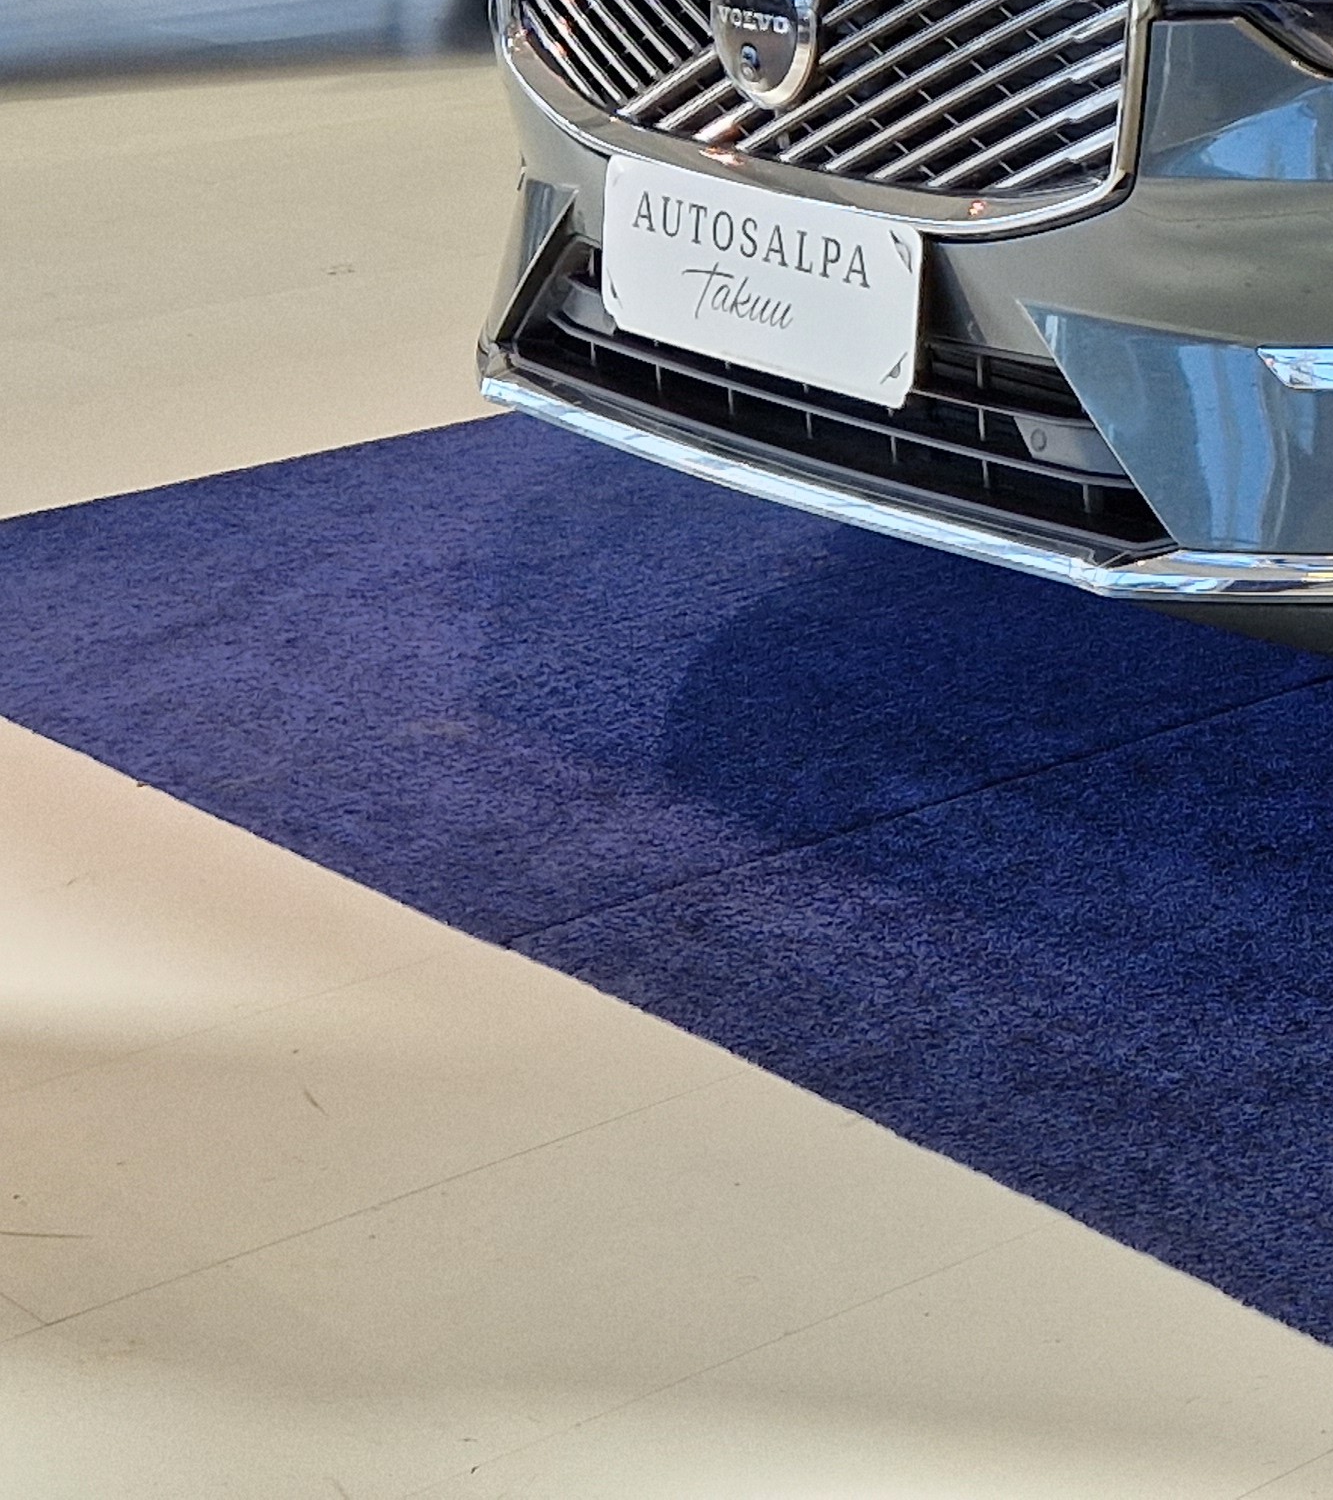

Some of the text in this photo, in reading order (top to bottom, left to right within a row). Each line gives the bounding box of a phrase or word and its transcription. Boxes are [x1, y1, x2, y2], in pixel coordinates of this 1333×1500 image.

[718, 4, 790, 34] VOLVO
[632, 190, 872, 289] AUTOSALPA
[682, 262, 794, 330] Takuu
